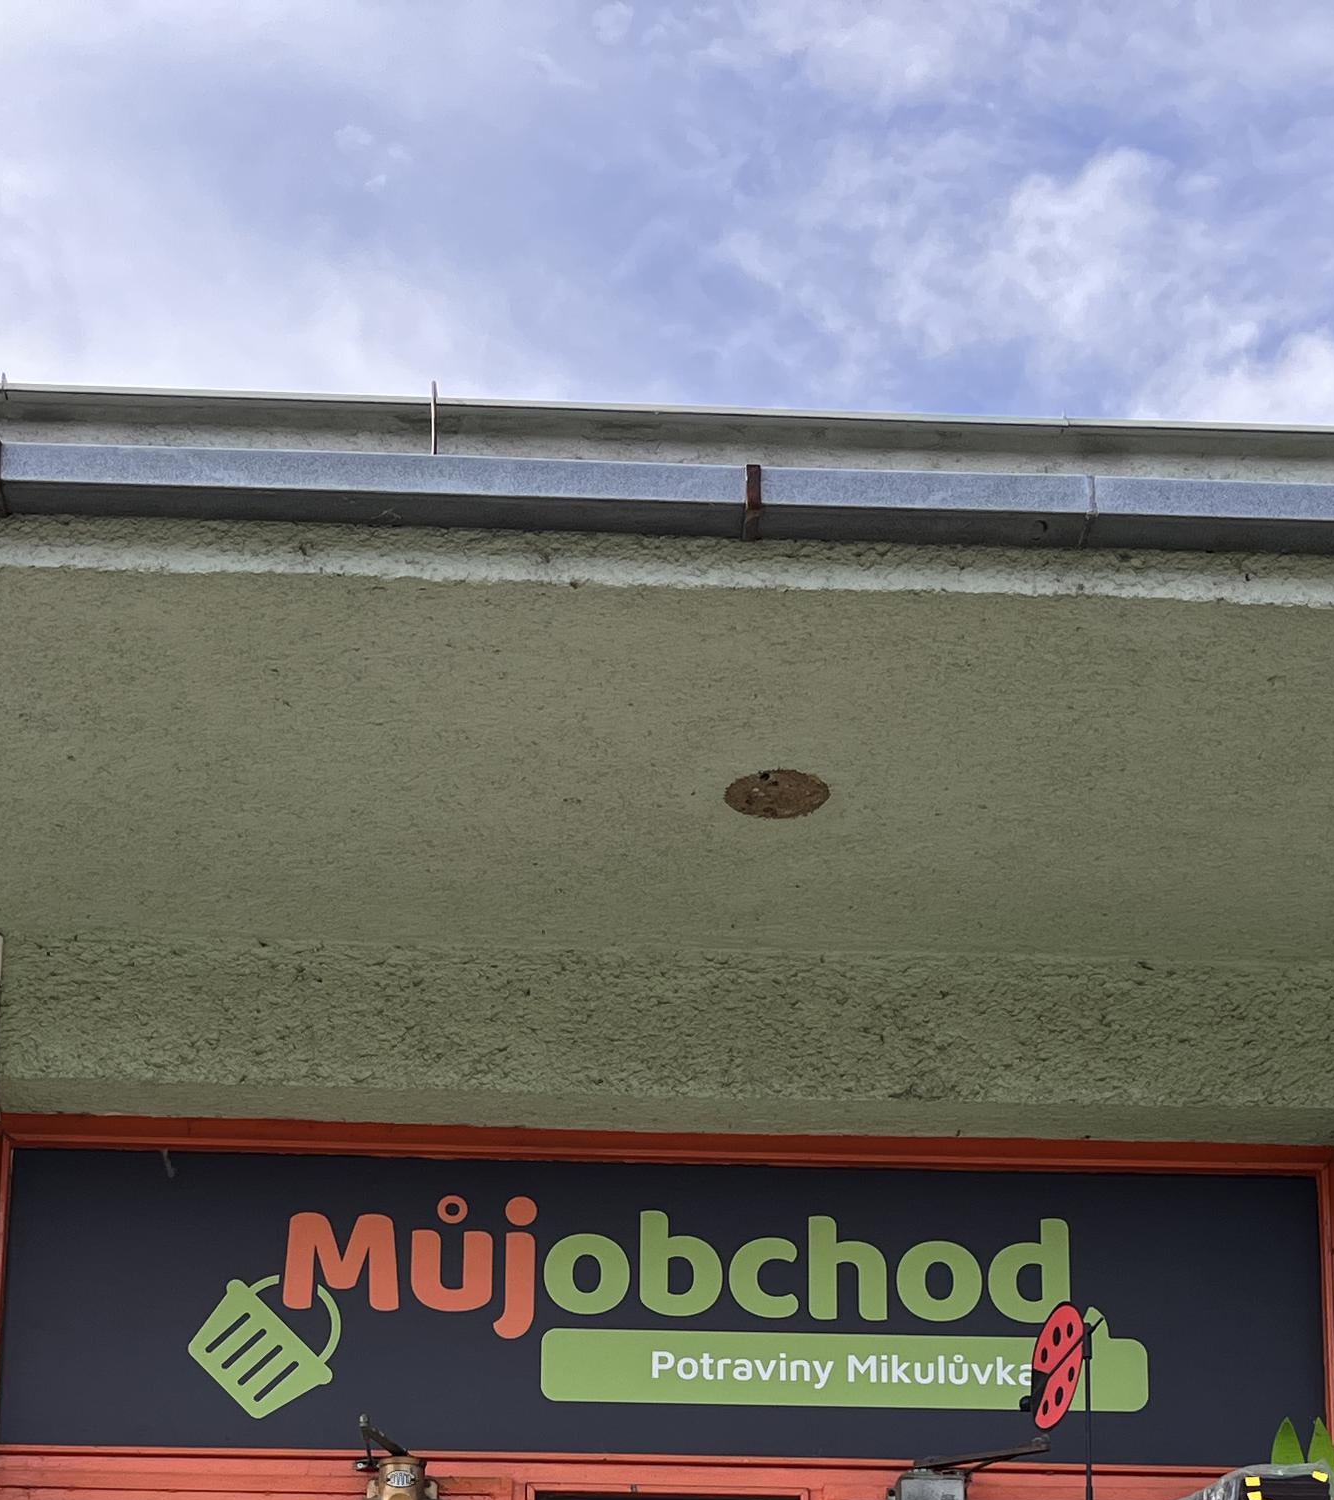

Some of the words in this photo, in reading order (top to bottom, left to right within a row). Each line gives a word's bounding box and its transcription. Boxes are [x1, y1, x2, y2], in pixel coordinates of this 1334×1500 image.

[280, 1194, 1072, 1340] Můjobchod
[651, 1350, 834, 1390] Potraviny
[847, 1353, 1033, 1386] Mikulůvka
